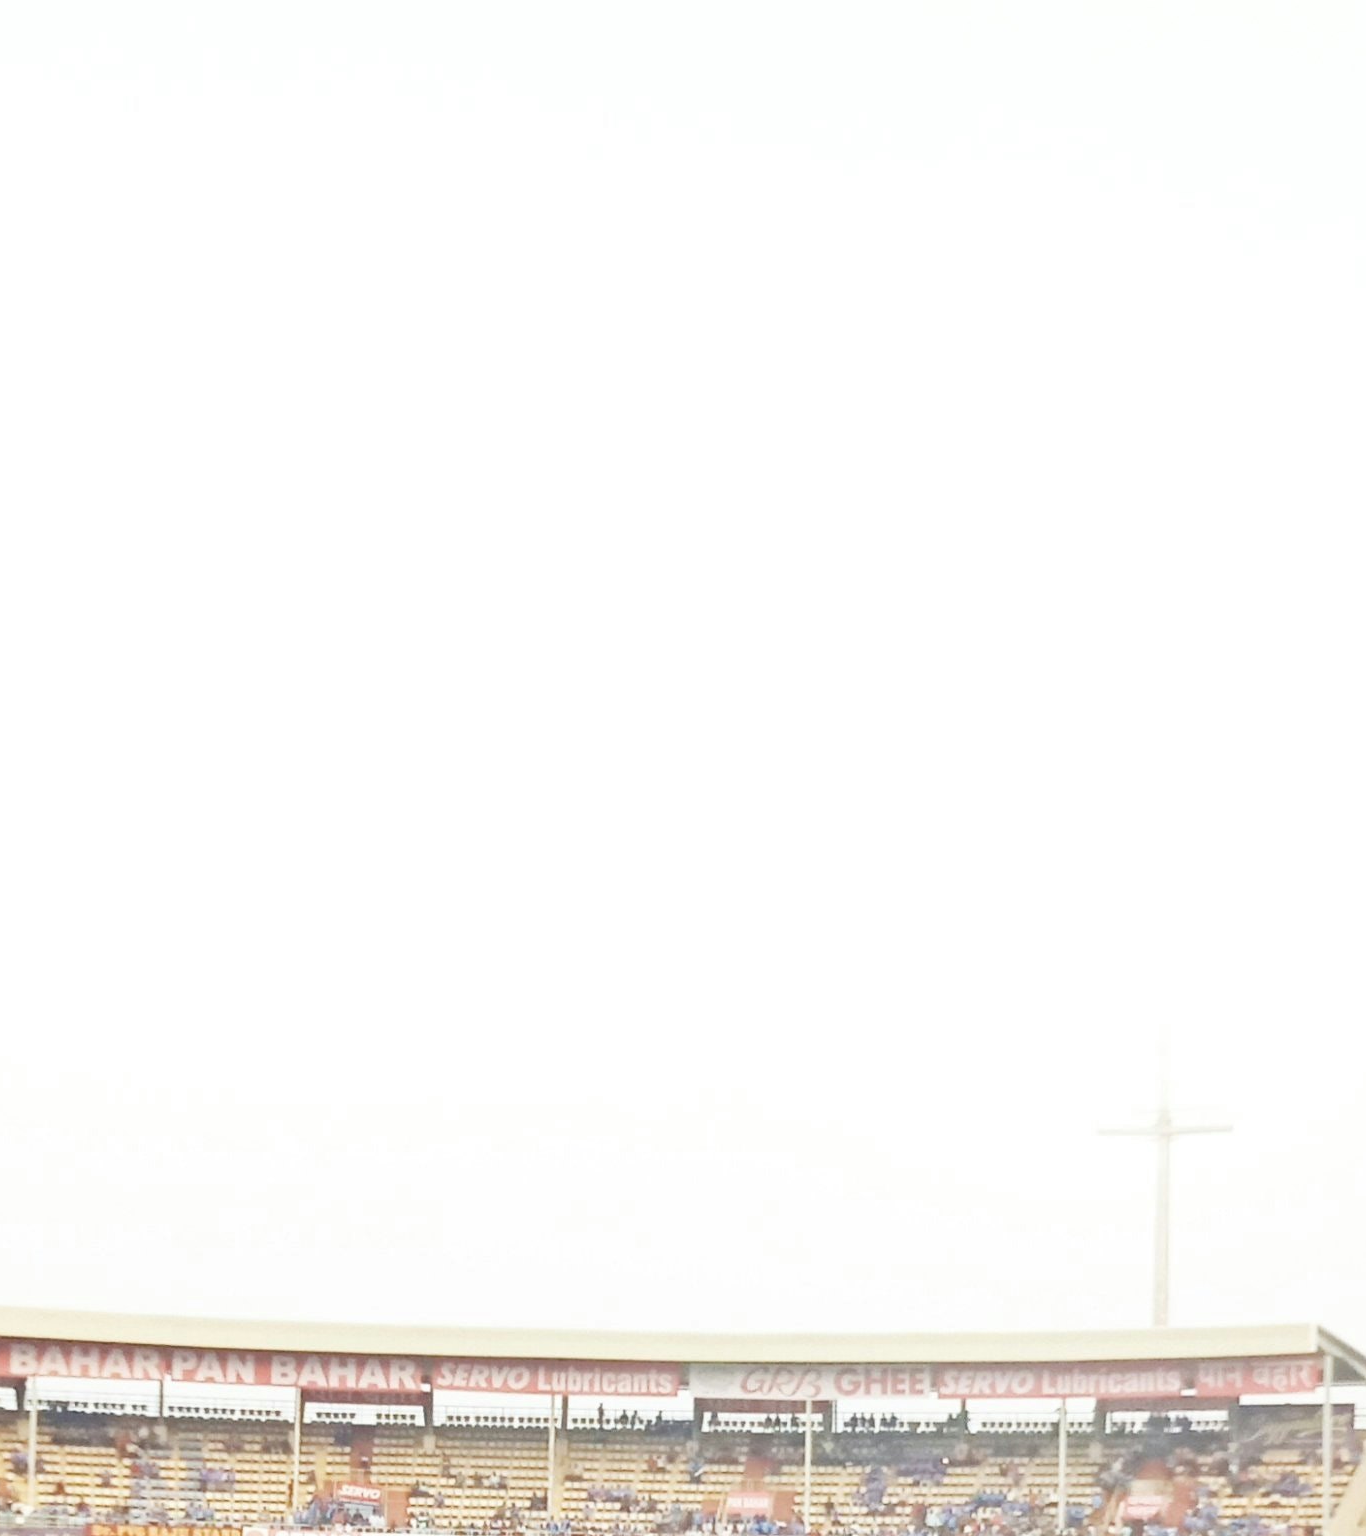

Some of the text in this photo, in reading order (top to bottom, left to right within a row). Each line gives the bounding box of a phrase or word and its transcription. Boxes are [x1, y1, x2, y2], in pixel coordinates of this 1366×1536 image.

[9, 1343, 163, 1380] BAHAR
[171, 1350, 421, 1391] PAN BAHAR
[437, 1362, 673, 1395] SERVO Lubricants
[836, 1367, 925, 1396] GHEE
[939, 1366, 1182, 1395] SERVO Lubricants
[339, 1484, 381, 1500] SERVO
